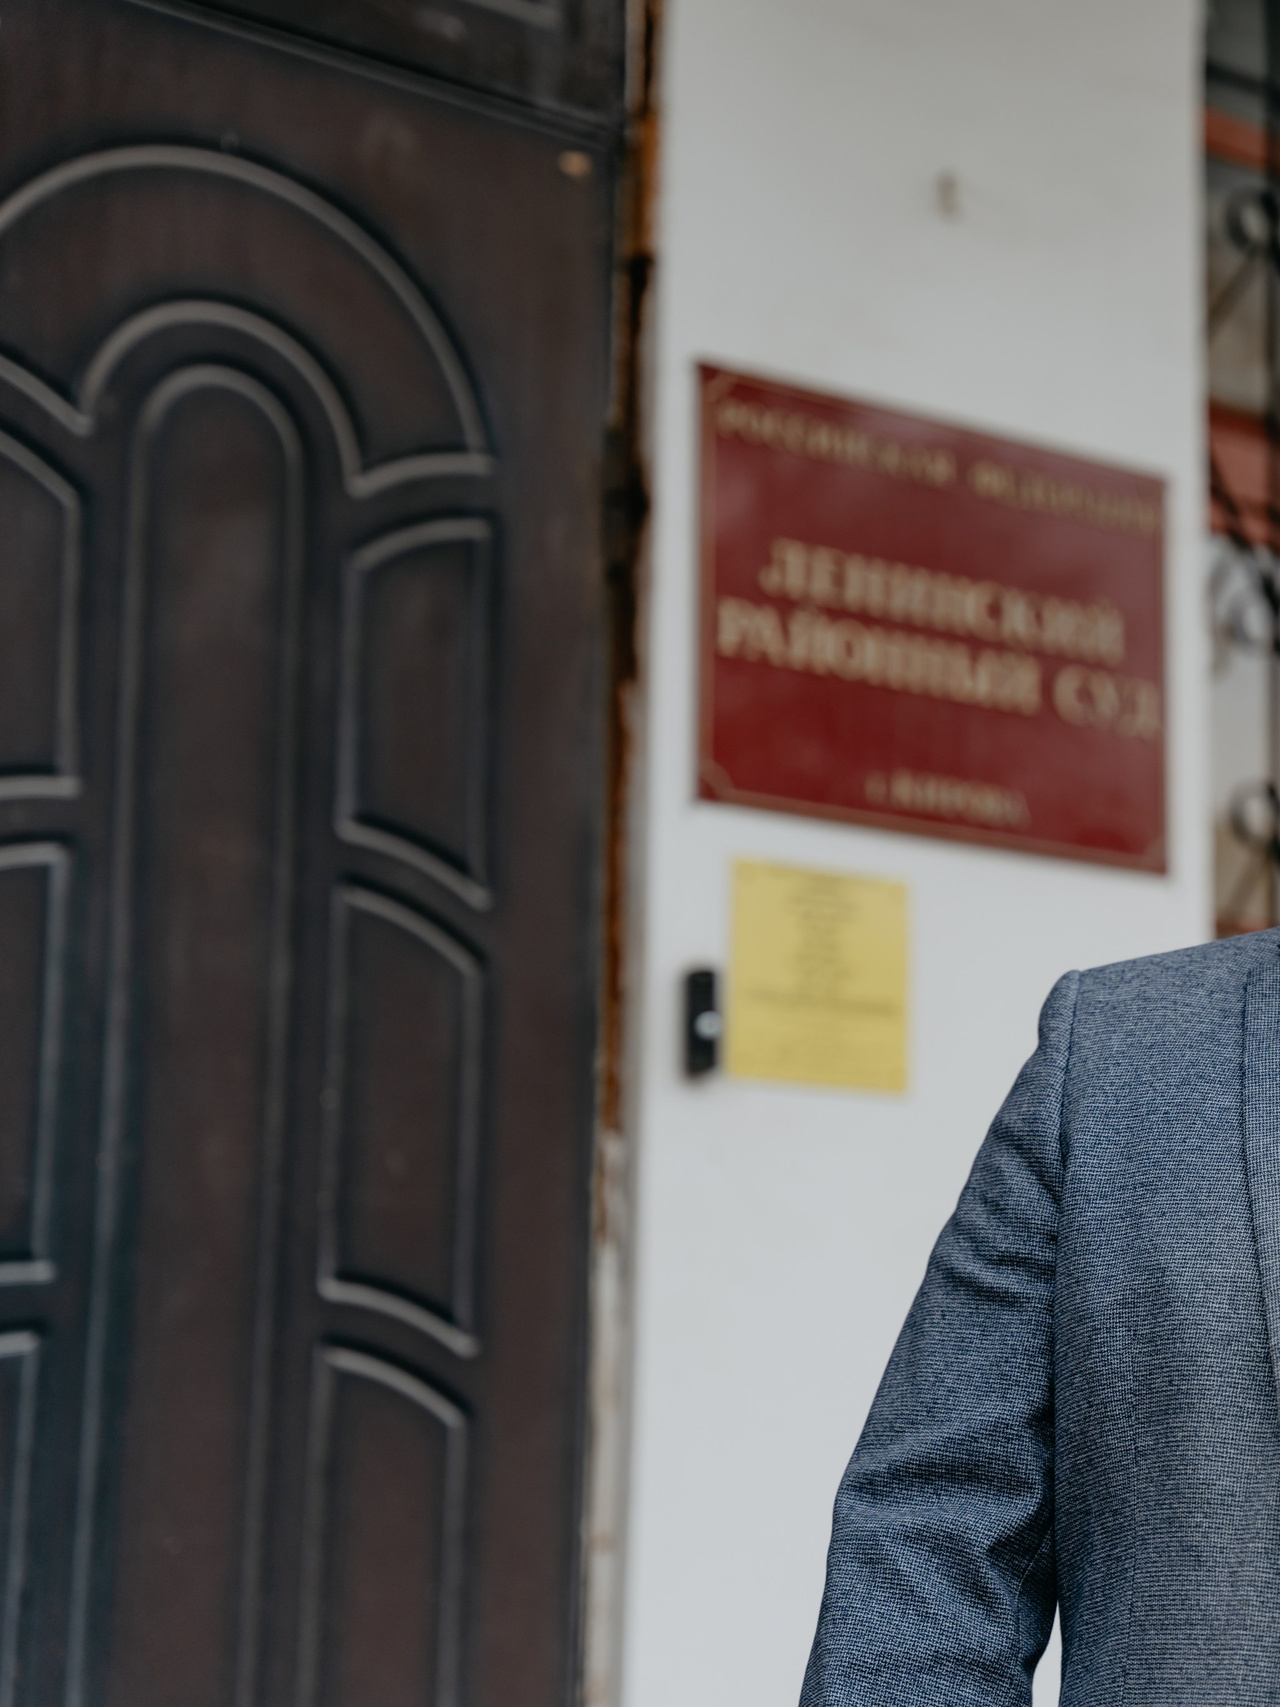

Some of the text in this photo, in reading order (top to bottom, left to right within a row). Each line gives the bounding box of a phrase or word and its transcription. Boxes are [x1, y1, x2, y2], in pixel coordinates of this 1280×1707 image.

[718, 596, 1161, 741] РАЙОННЫЙ СУД
[760, 538, 1126, 666] ЛЕНИНСКИЙ
